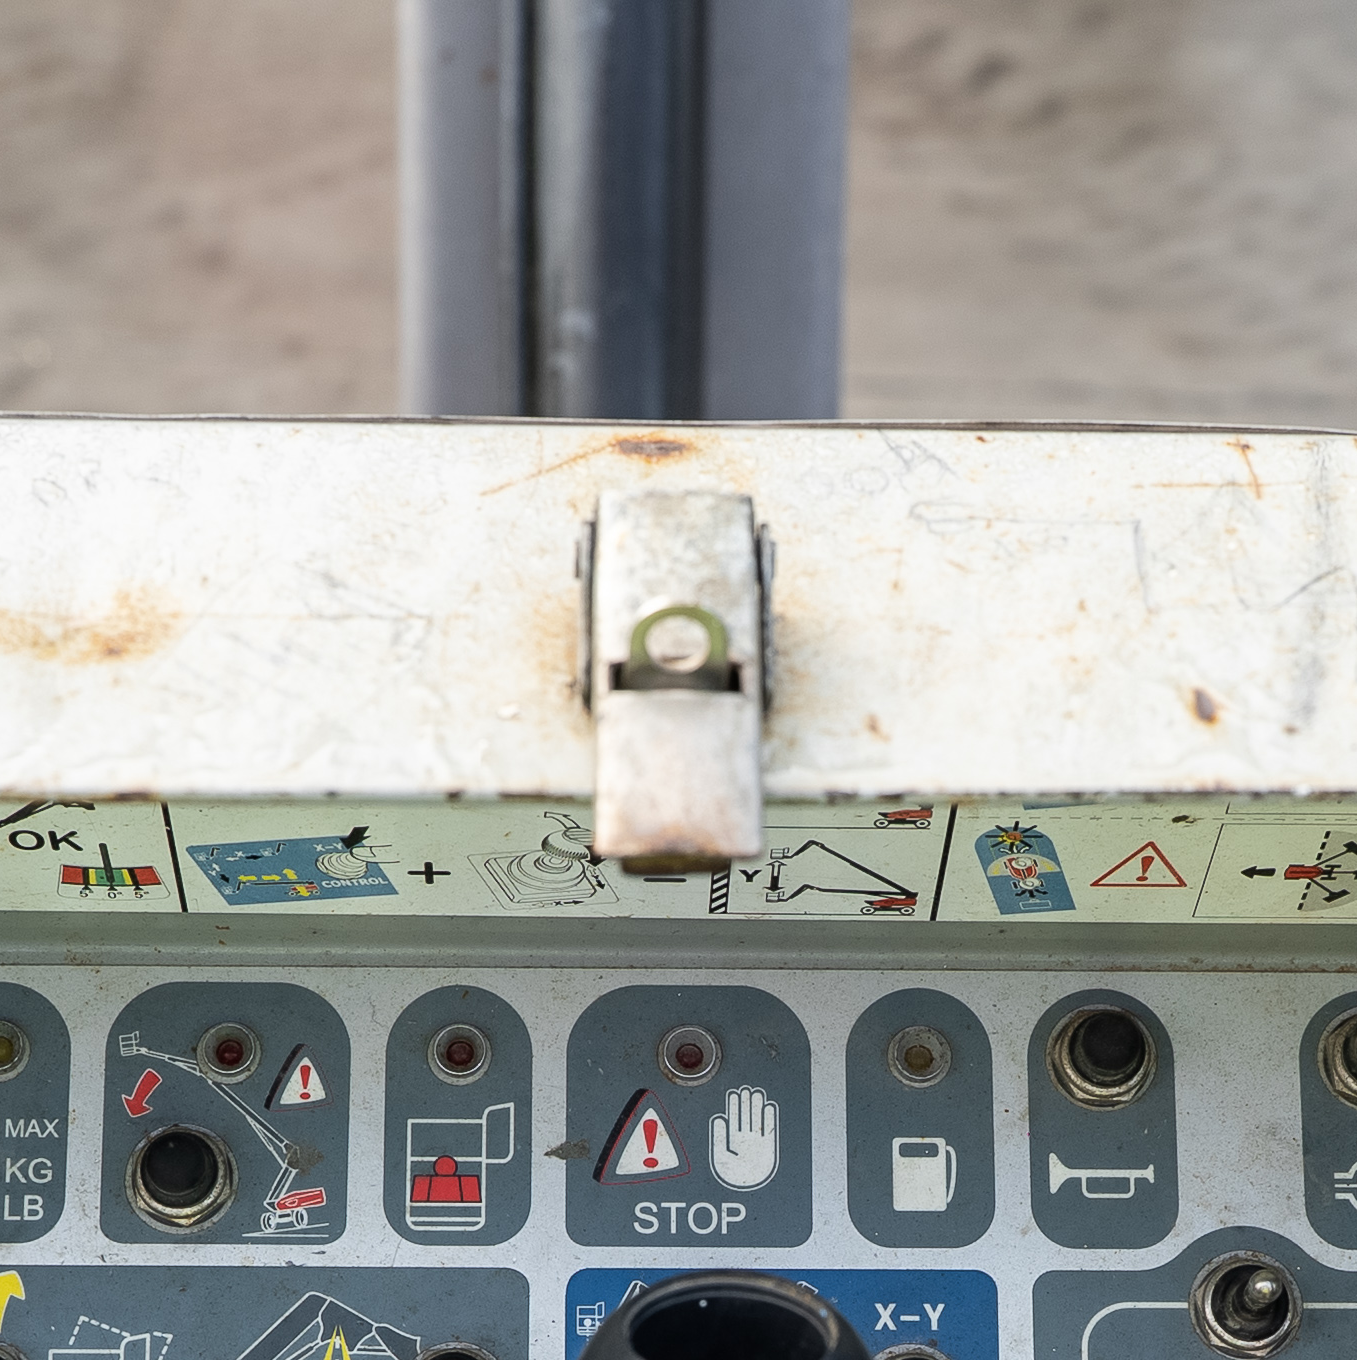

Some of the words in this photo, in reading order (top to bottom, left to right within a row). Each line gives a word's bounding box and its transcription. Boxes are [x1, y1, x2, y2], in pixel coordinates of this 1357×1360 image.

[8, 829, 84, 851] OK
[321, 877, 389, 888] CONTROL
[738, 869, 762, 883] Y
[4, 1118, 60, 1138] MAX
[5, 1157, 53, 1183] KG
[3, 1194, 44, 1220] LB
[633, 1201, 747, 1235] STOP
[874, 1302, 945, 1331] X-Y
